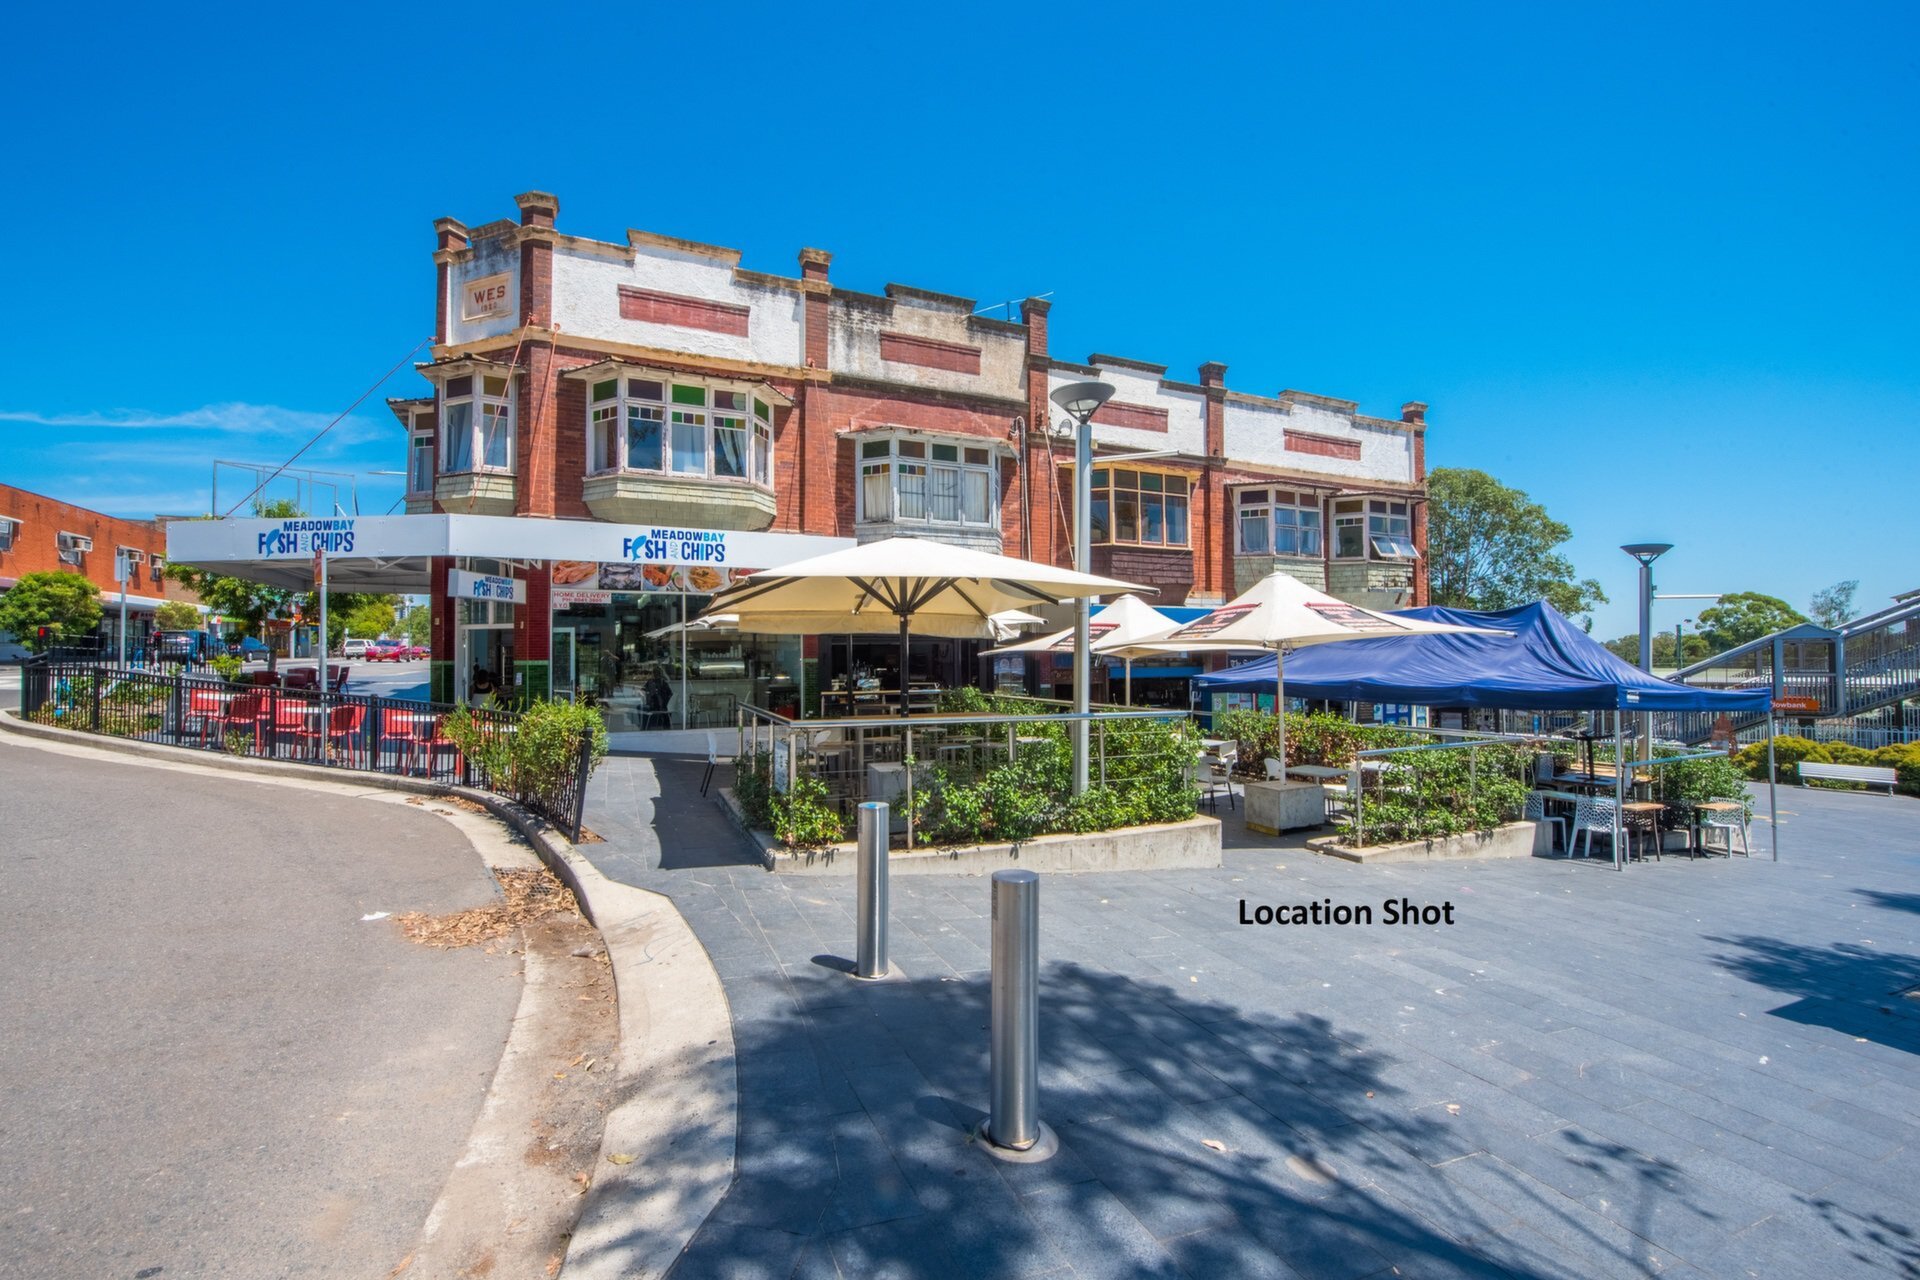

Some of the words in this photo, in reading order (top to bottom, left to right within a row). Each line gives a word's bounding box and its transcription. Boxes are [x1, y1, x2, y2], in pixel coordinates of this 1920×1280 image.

[474, 285, 506, 304] WES
[283, 519, 355, 532] MEADOWBAY
[311, 531, 355, 553] CHIPS
[651, 529, 725, 542] MEADOWBAY
[681, 541, 726, 562] CHIPS
